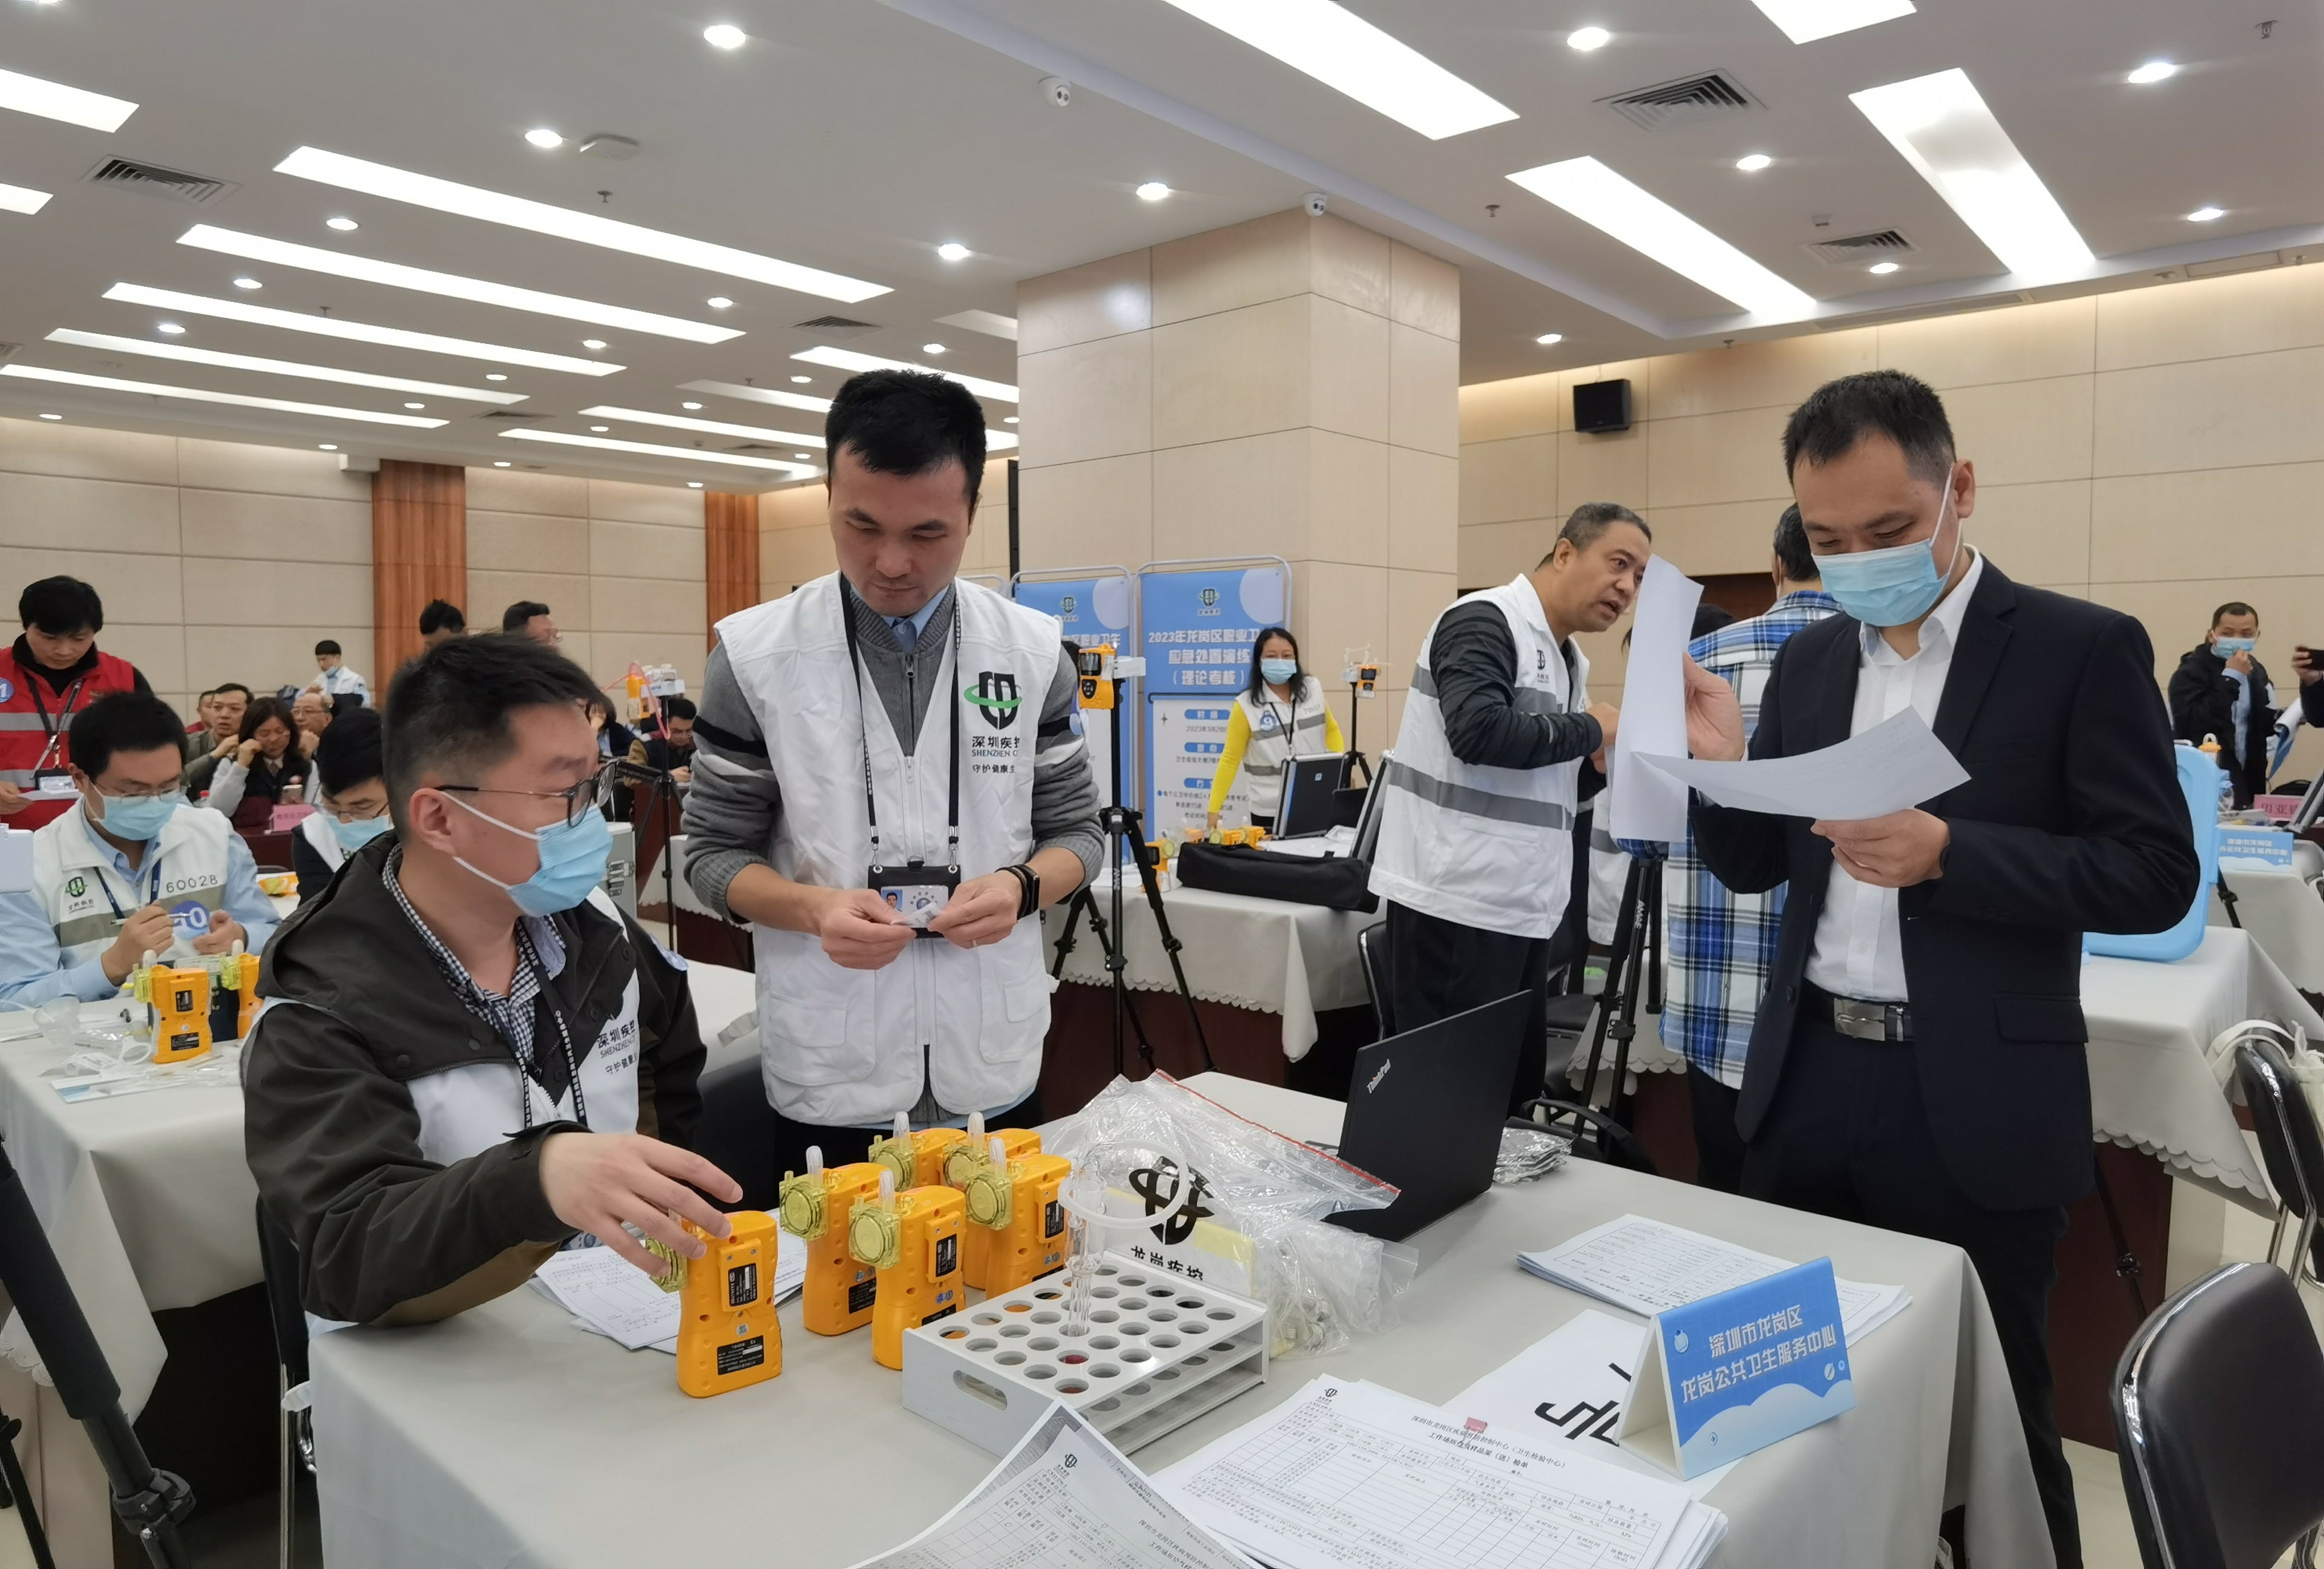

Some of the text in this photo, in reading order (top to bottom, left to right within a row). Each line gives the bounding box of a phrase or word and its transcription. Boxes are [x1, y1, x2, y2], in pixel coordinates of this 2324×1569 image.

[1169, 648, 1250, 664] 应急处置演练
[166, 874, 218, 893] 60028
[1367, 1058, 1391, 1094] ThinkPad
[1709, 1304, 1804, 1359] 深圳市龙岗区
[1680, 1324, 1837, 1404] 龙岗公共卫生服务中心
